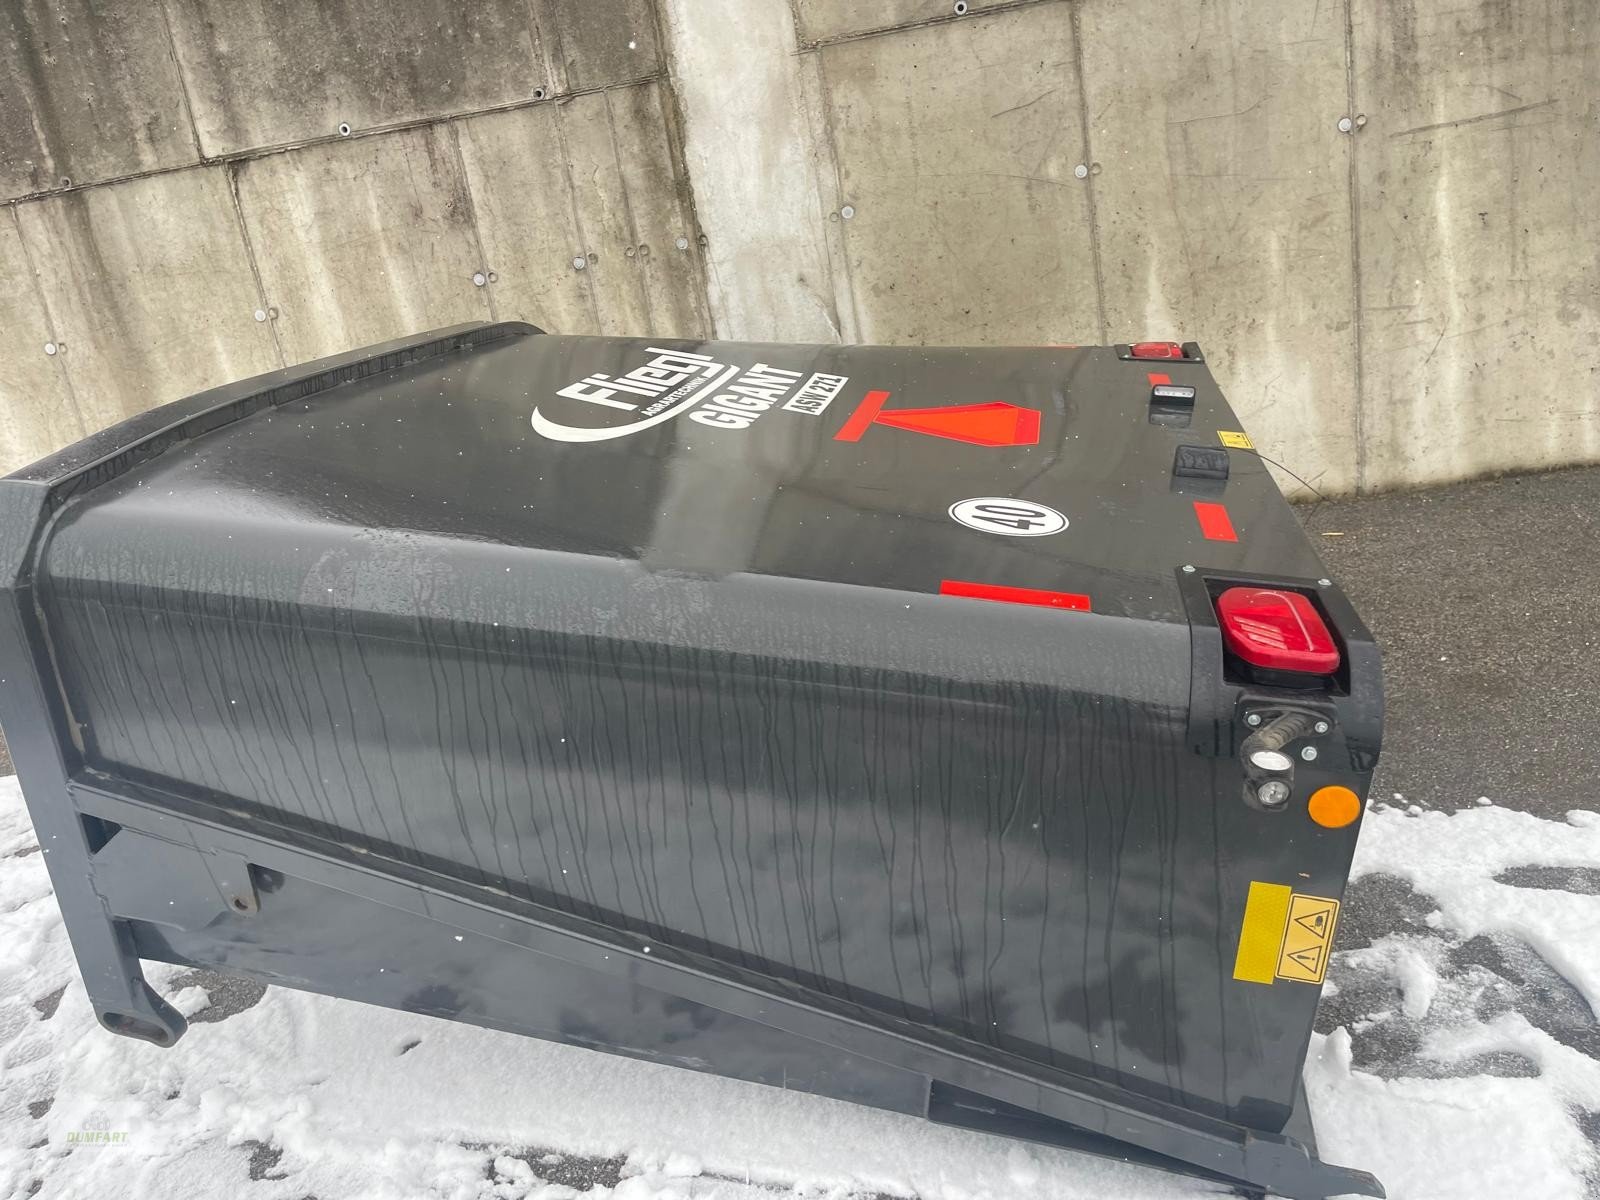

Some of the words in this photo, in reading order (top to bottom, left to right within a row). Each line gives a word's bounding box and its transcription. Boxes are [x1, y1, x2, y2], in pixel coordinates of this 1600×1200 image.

[556, 347, 725, 411] Fliegl
[640, 376, 709, 417] AGRARTECHNIK
[689, 363, 804, 429] GIGANT
[790, 391, 828, 413] ASW
[809, 376, 843, 393] 271
[971, 504, 1047, 530] 40
